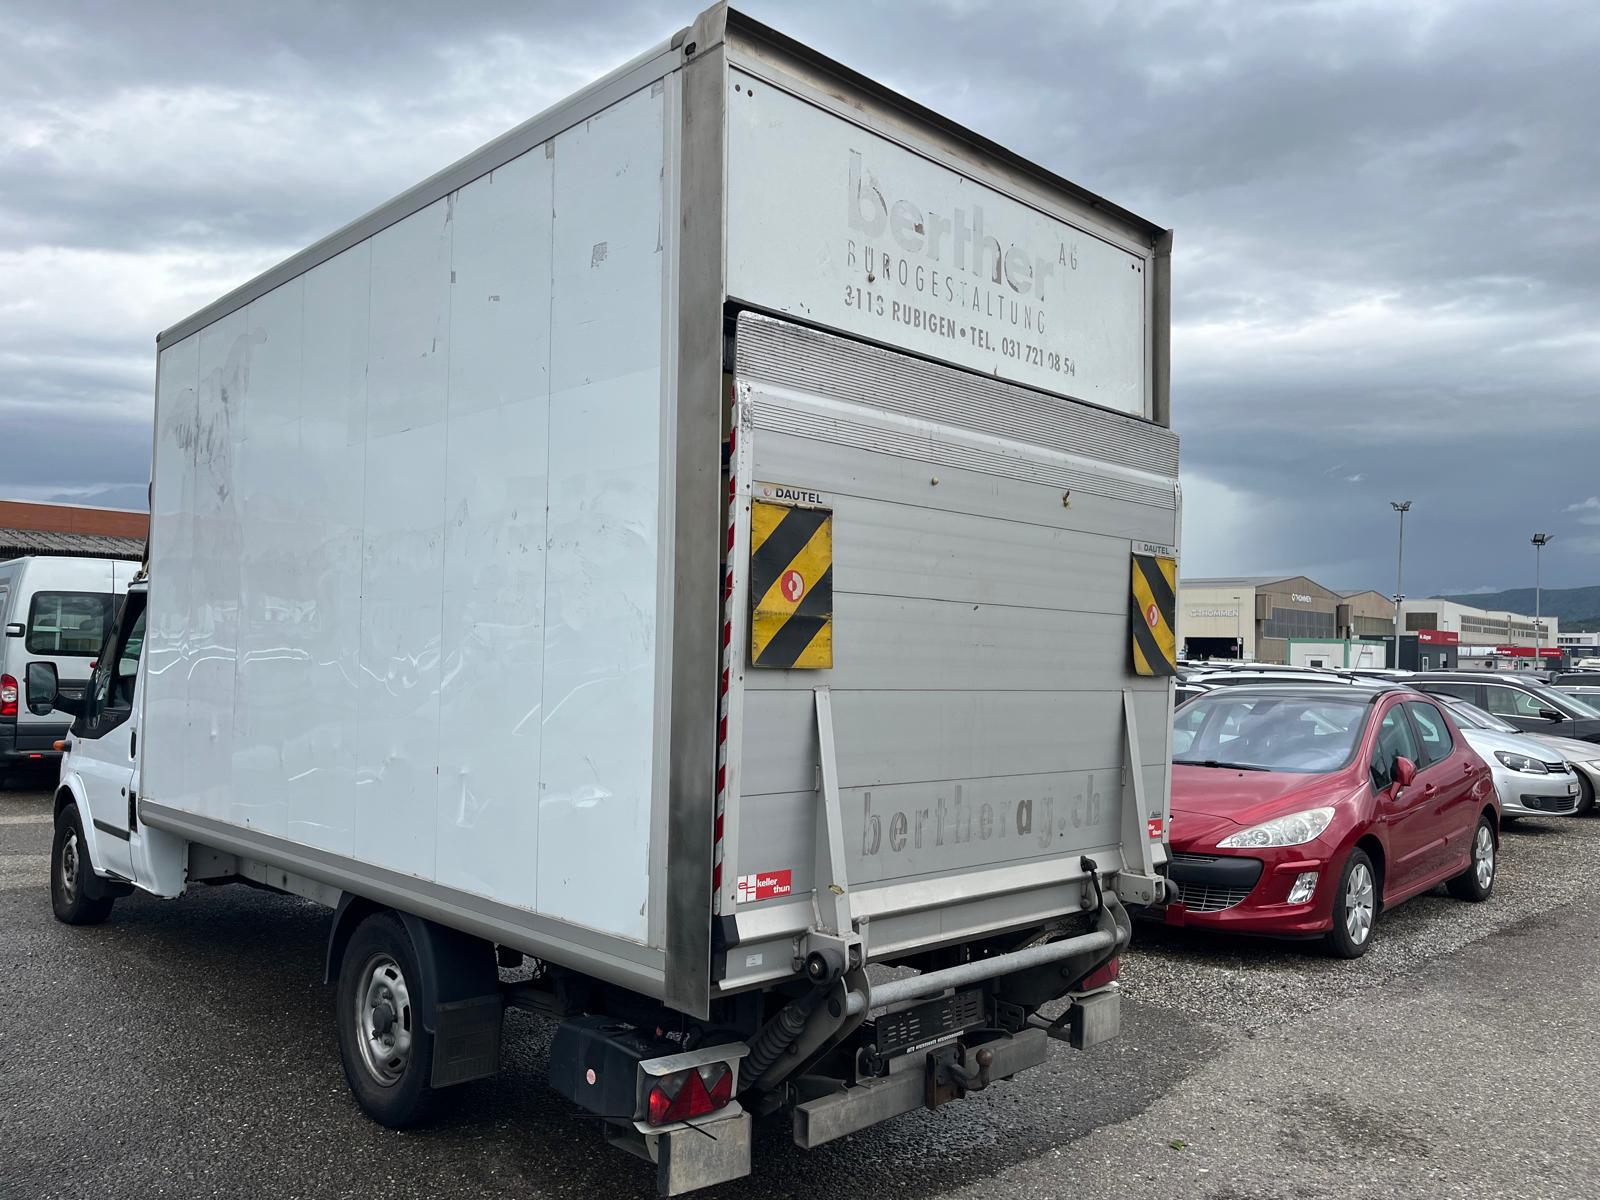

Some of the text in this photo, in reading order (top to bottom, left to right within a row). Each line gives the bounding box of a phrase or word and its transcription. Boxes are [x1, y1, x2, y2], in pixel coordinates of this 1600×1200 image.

[848, 149, 1055, 302] berther
[1058, 242, 1078, 270] AG
[844, 285, 885, 317] 3113
[892, 301, 956, 339] RUBIGEN
[970, 326, 996, 352] TEL.
[1002, 337, 1020, 360] 031
[1026, 345, 1043, 367] 721
[1048, 351, 1061, 372] 08
[775, 487, 823, 504] DAUTEL
[1143, 543, 1170, 555] DAUTEL
[757, 877, 778, 888] keller
[773, 885, 791, 894] thun
